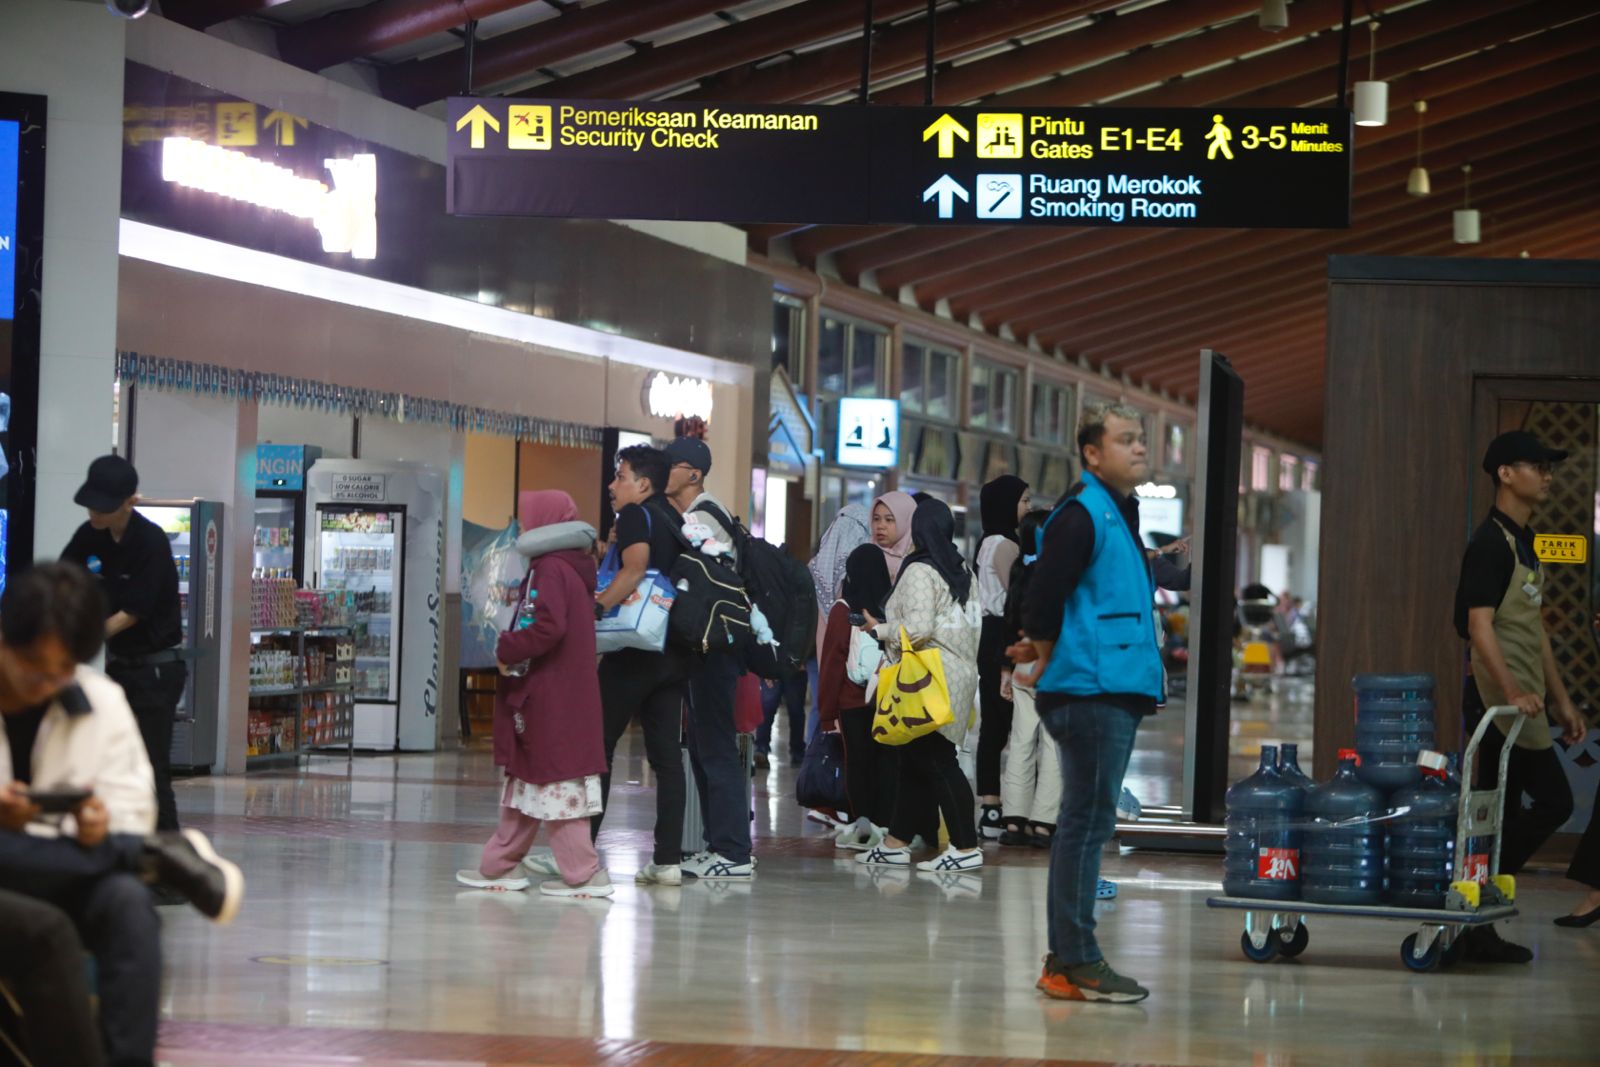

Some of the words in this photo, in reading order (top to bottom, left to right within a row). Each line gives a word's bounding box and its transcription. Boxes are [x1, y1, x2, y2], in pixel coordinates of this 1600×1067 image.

[560, 105, 697, 128] Pemeriksaan
[703, 109, 818, 130] Keamanan
[1030, 116, 1085, 136] Pintu
[1291, 122, 1329, 135] Menit
[560, 127, 645, 151] Security
[650, 128, 719, 149] Check
[1030, 140, 1093, 160] Gates
[1101, 127, 1183, 152] E1-E4
[1241, 126, 1287, 150] 3-5
[1291, 140, 1343, 153] Minutes
[1030, 174, 1101, 202] Ruang
[1107, 175, 1202, 195] Merokok
[1030, 198, 1125, 222] Smoking
[1131, 198, 1197, 218] Room
[1541, 540, 1577, 548] TARIK
